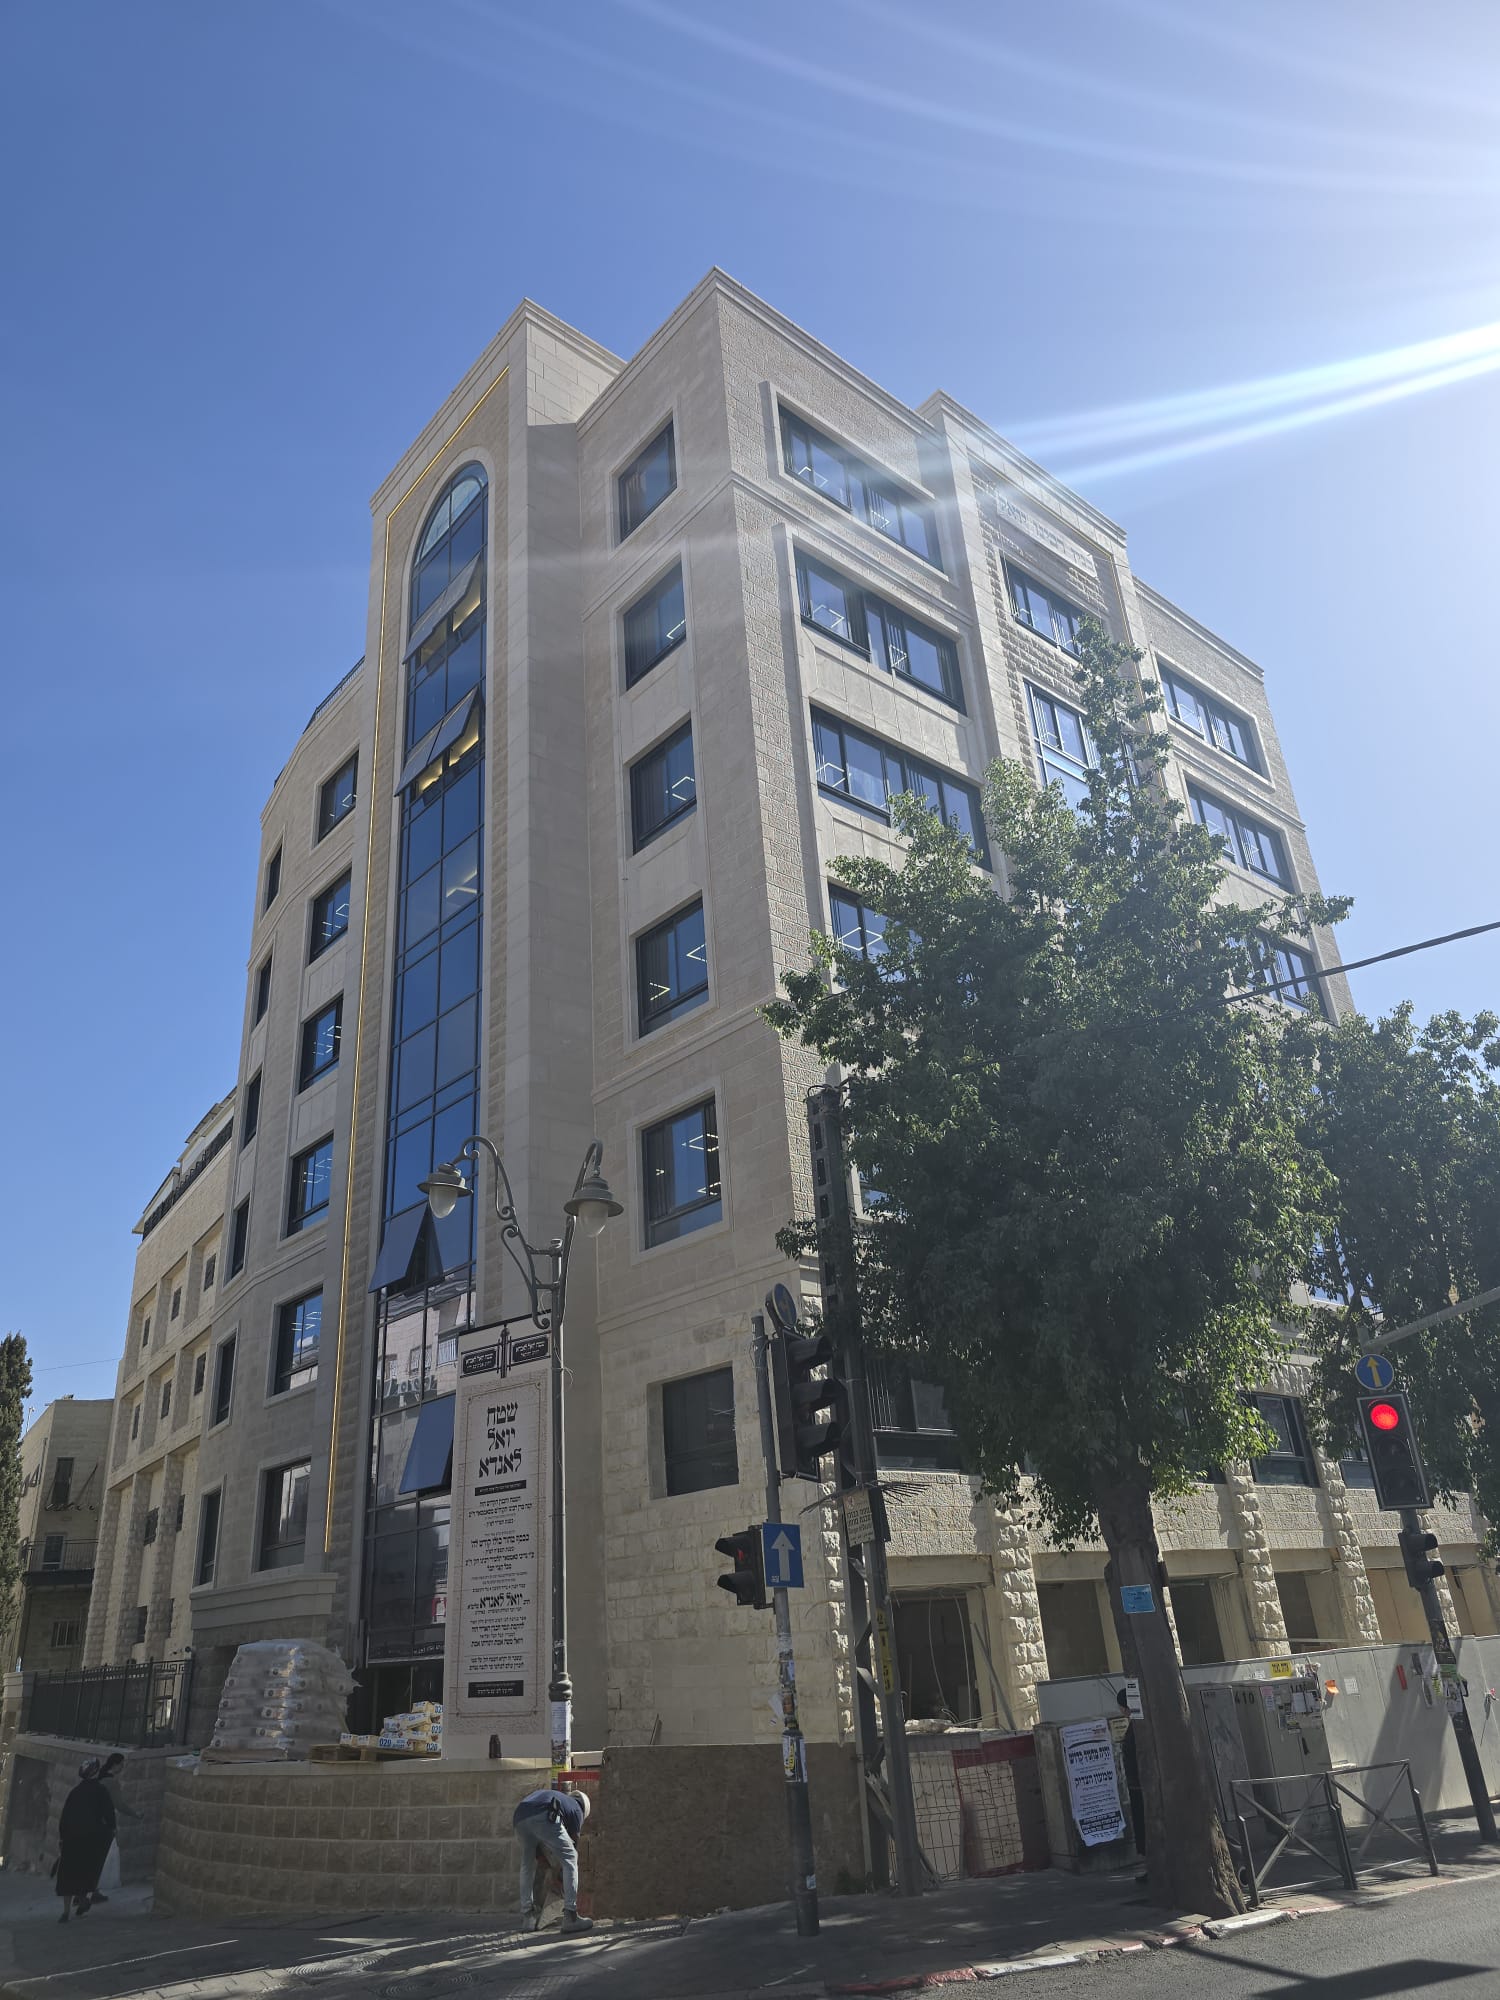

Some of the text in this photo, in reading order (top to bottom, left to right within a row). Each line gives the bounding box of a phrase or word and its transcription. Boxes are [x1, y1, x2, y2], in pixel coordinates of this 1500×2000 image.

[487, 1402, 518, 1426] שטח
[487, 1427, 516, 1451] יואל
[478, 1448, 522, 1478] לאנדא
[480, 1593, 505, 1608] לאנדא
[506, 1592, 522, 1606] יואל
[1074, 1770, 1113, 1789] שמעון הצדיק
